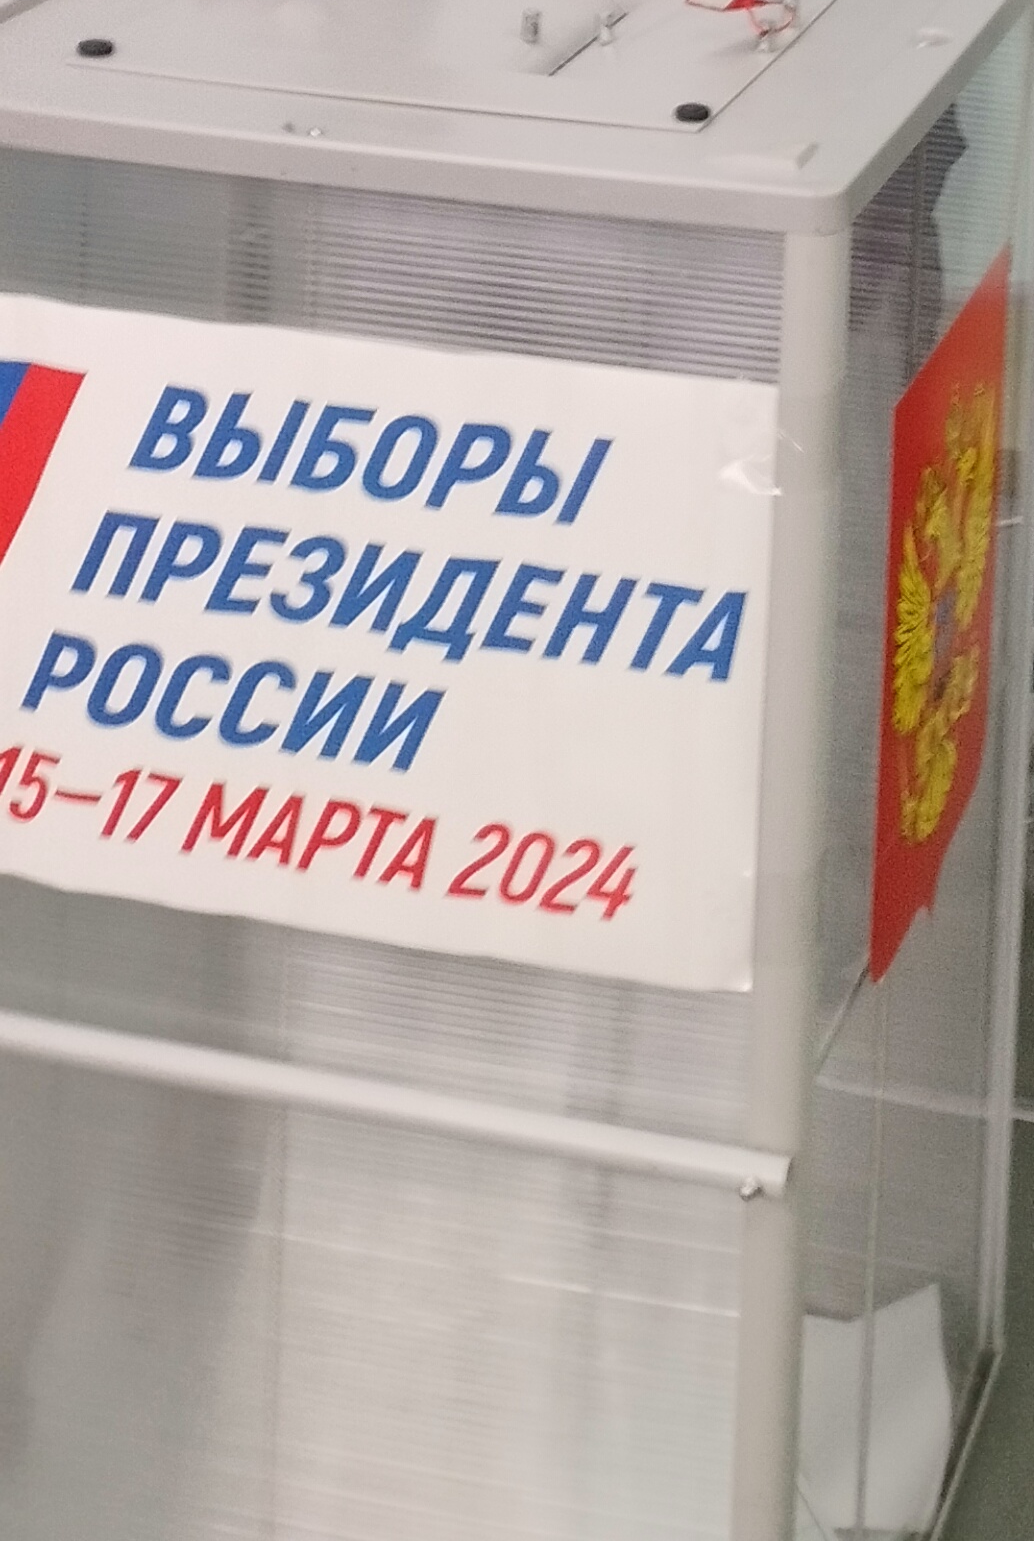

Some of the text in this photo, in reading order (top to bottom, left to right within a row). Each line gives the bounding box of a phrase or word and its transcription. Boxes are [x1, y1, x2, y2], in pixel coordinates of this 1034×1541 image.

[130, 386, 611, 524] ВЫБОРЫ
[72, 512, 747, 682] ПРЕЗИДЕНТА
[22, 634, 443, 771] РОССИИ
[181, 782, 437, 892] МАРТА
[447, 822, 636, 921] 2024
